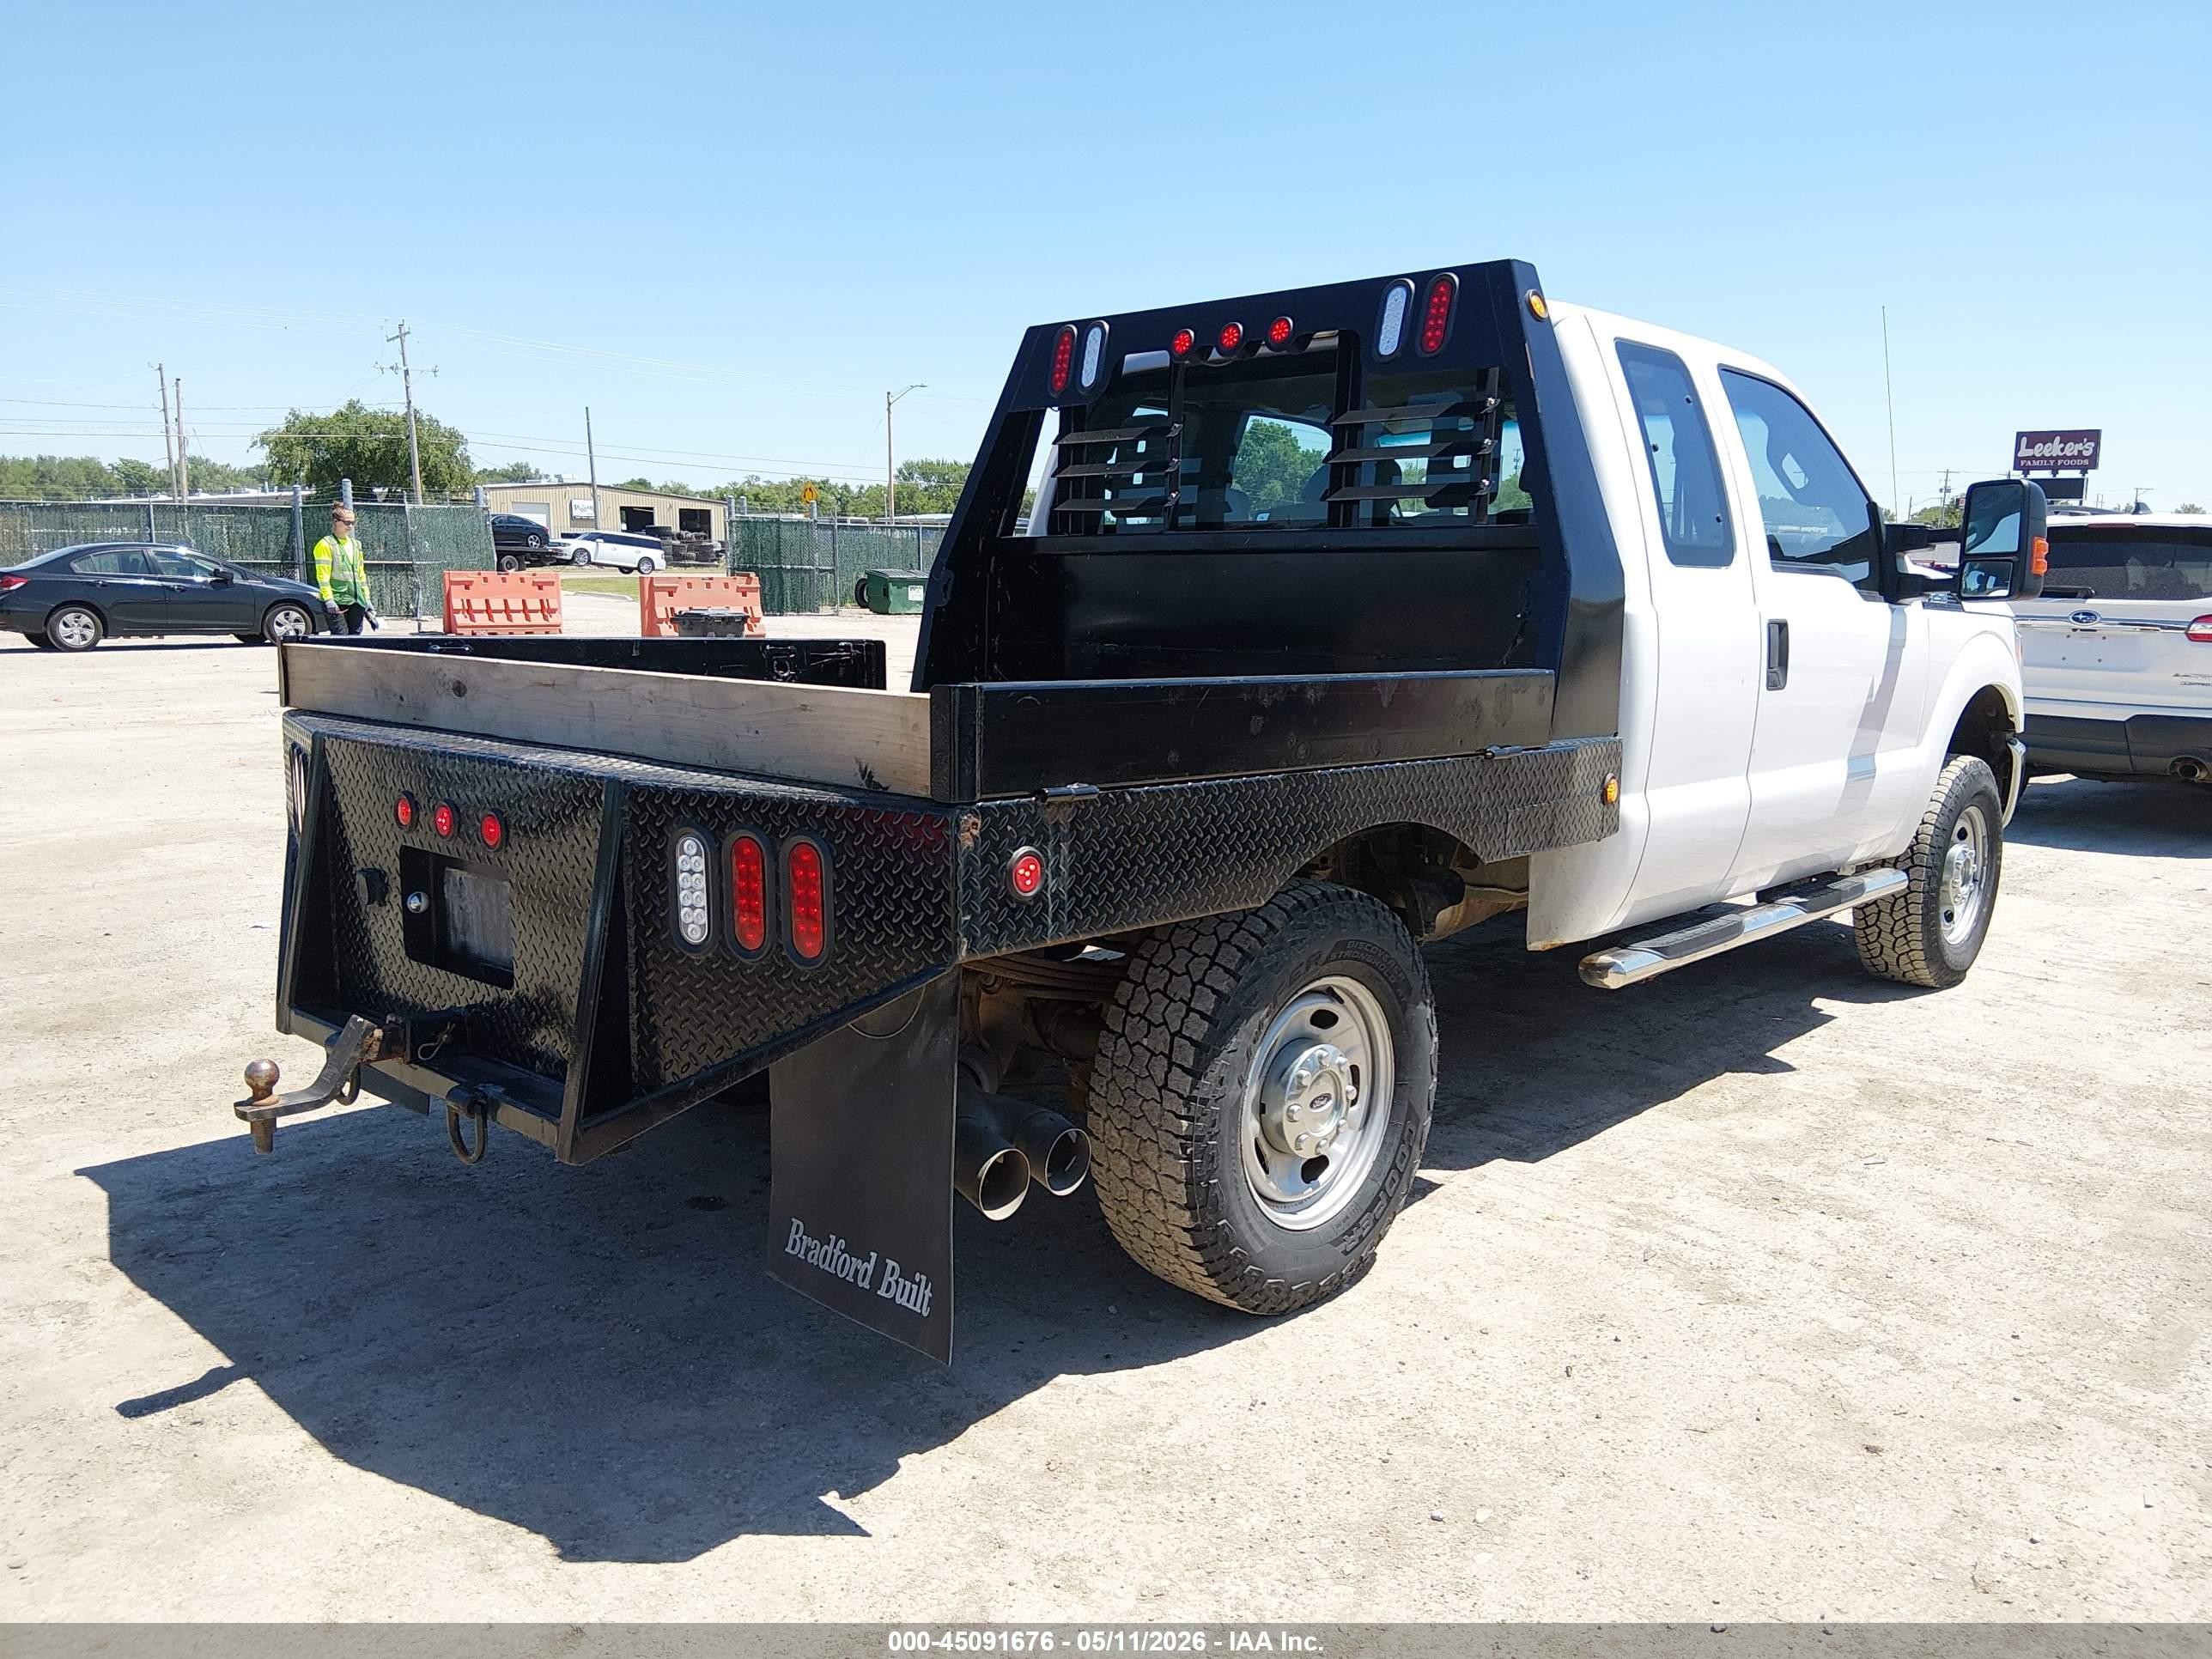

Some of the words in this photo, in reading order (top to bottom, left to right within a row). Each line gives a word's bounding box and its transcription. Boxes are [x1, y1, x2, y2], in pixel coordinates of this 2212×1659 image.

[2018, 436, 2095, 457] Leeker's
[1330, 951, 1397, 983] STRONGHOLD
[1342, 1127, 1418, 1254] COOPER
[785, 1218, 878, 1290] Bradford
[877, 1258, 933, 1317] Built
